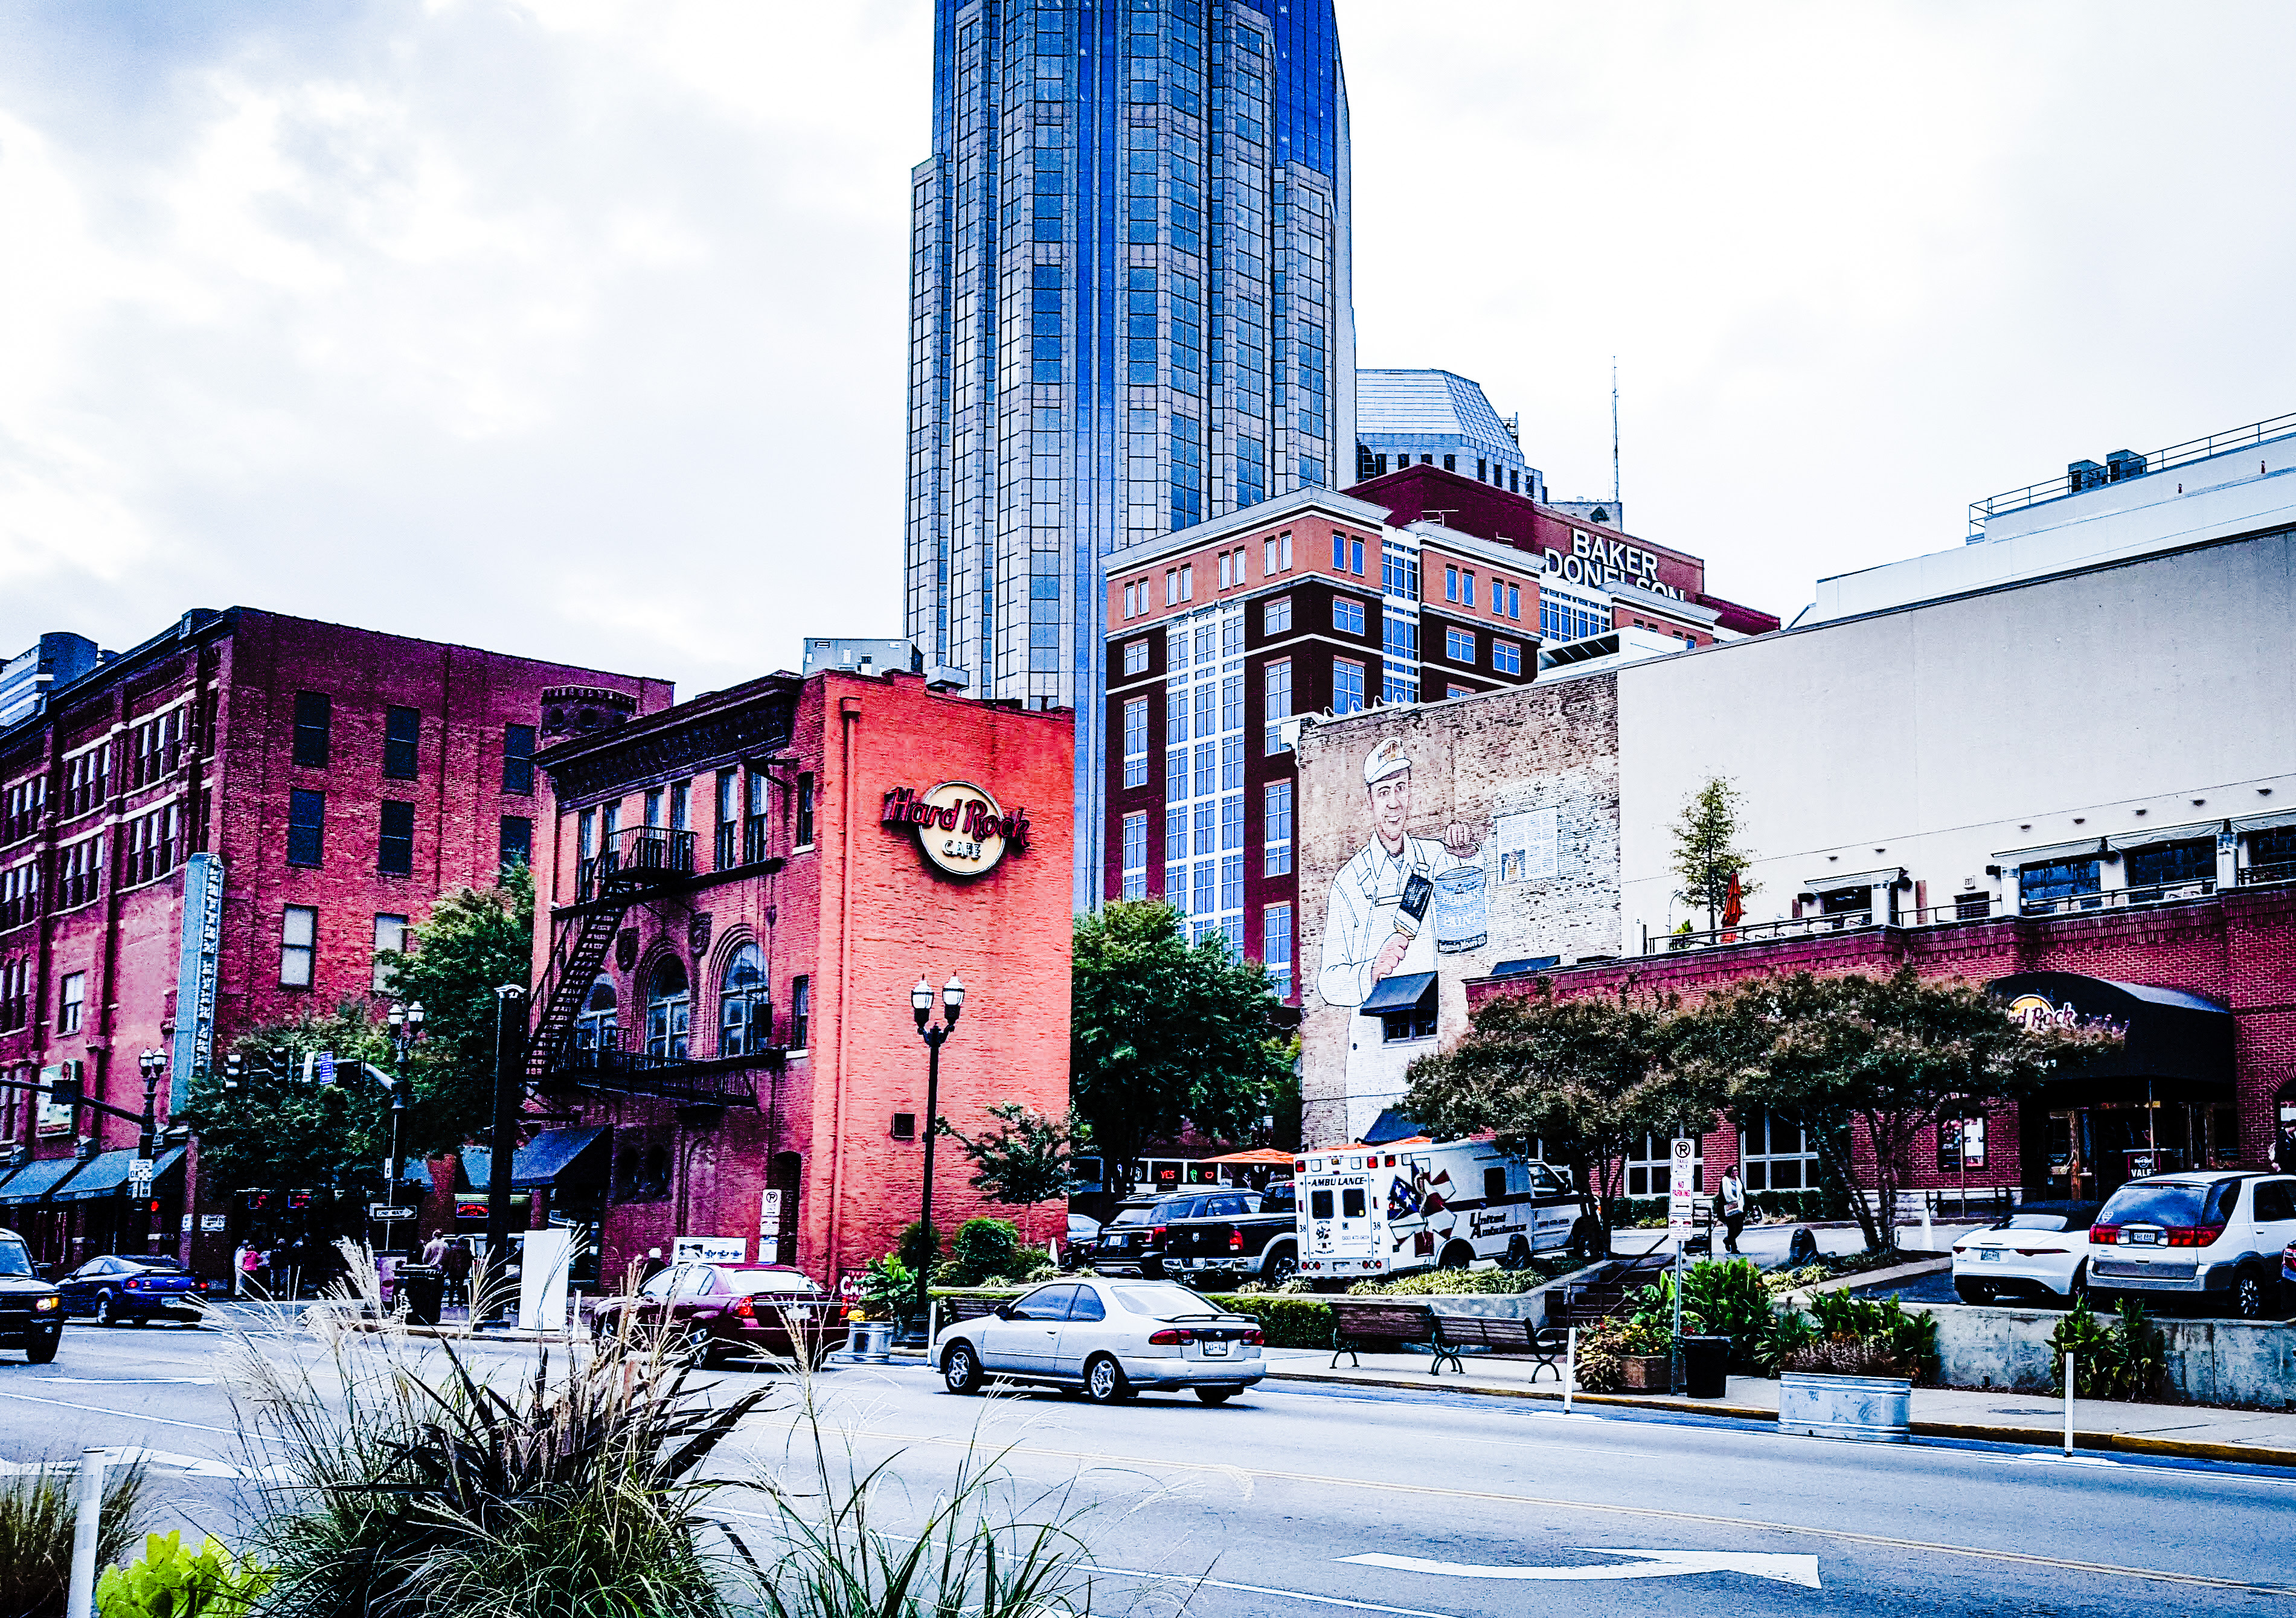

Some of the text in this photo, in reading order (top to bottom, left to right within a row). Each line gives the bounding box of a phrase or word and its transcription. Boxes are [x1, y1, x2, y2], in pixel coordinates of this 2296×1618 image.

[1573, 528, 1659, 581] BAKER
[885, 787, 1030, 847] Hard Rock
[941, 840, 981, 860] CAFE
[1311, 1177, 1364, 1186] AMBULANCE
[1373, 1221, 1381, 1230] 38
[1470, 1212, 1506, 1227] United
[1470, 1224, 1527, 1239] Ambulance
